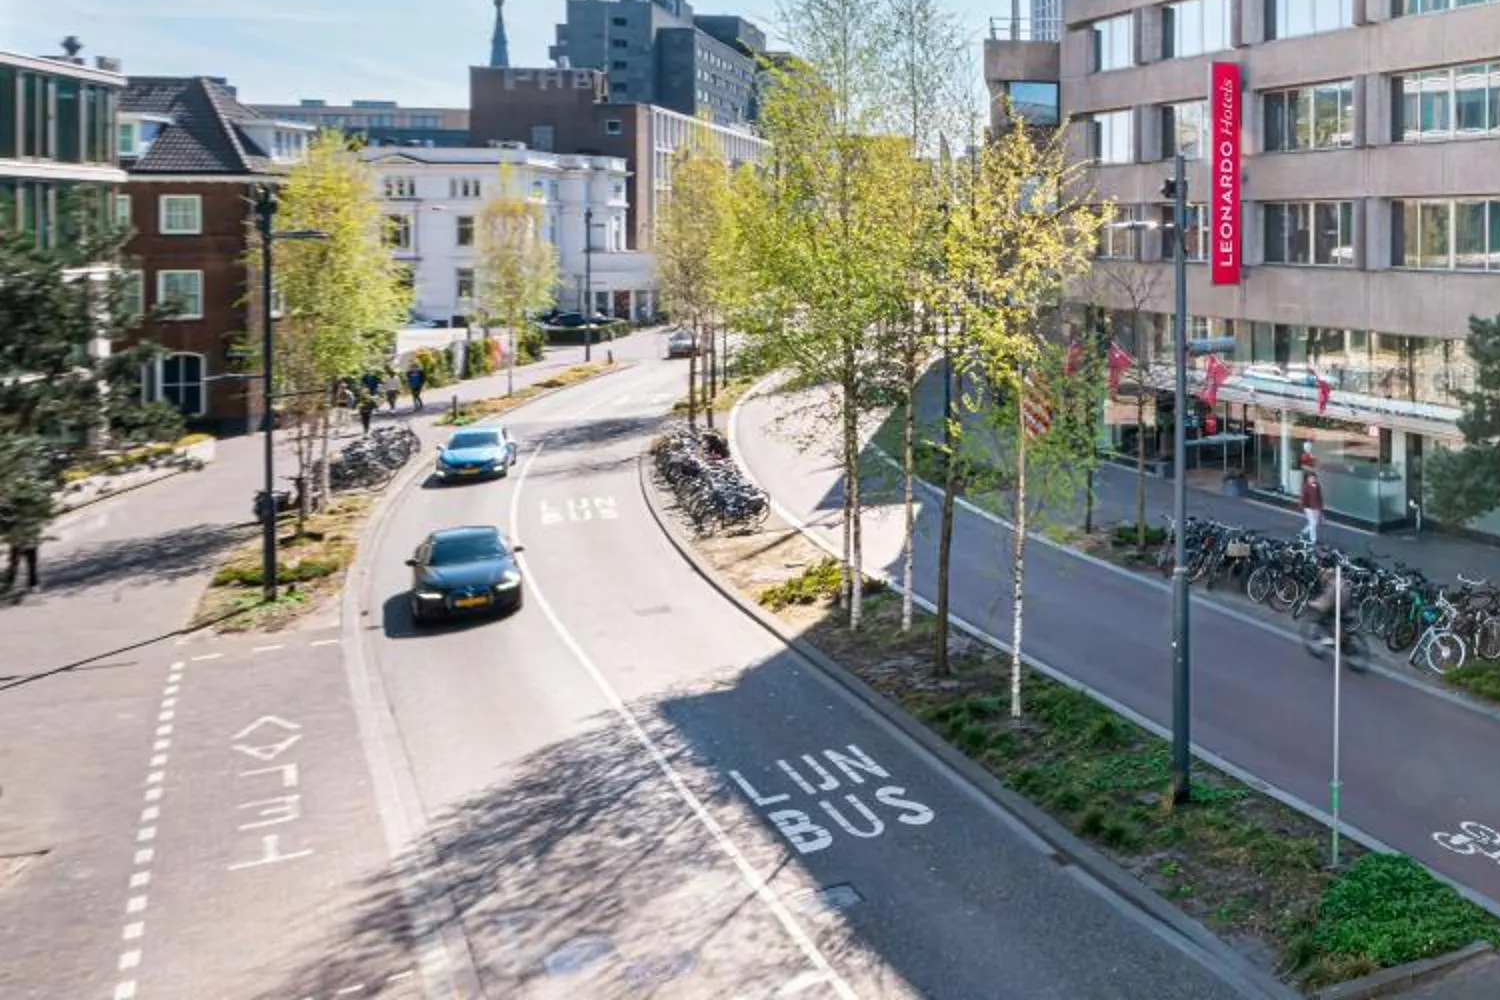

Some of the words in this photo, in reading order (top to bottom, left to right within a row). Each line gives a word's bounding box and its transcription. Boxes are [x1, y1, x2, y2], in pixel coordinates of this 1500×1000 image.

[1219, 78, 1233, 135] Hotels
[1219, 140, 1233, 268] LEONARDO
[728, 744, 891, 806] LIJN
[767, 785, 935, 853] BUS
